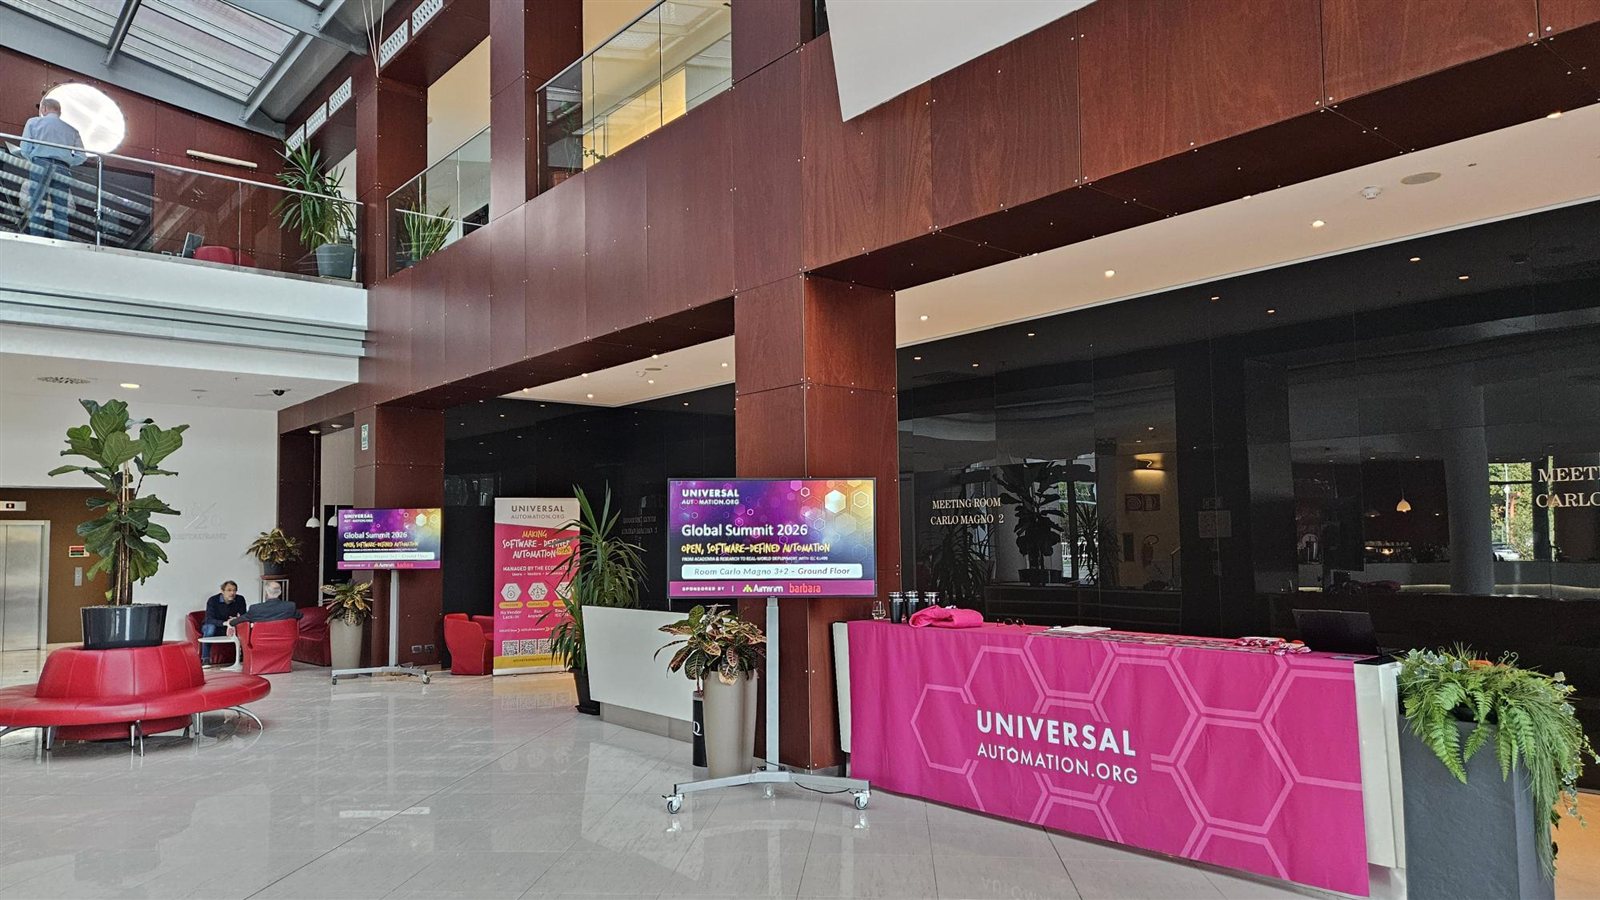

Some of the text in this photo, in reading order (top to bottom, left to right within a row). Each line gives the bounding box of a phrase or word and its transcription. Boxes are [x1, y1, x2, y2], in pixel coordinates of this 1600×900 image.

[1538, 466, 1600, 482] MEET
[682, 489, 739, 497] UNIVERSAL
[932, 497, 1001, 509] MEETING ROOM
[930, 513, 1004, 525] CARLO MAGNO 2
[522, 529, 547, 538] MAKING
[681, 524, 808, 536] Global Summit 2026
[502, 539, 537, 549] SOFTWARE
[681, 542, 830, 555] OPEN, SOFTWARE-DEFINED AUTOMATION
[513, 549, 556, 559] AUTOMATION
[743, 568, 771, 576] Magno
[774, 567, 789, 575] 3+2
[797, 567, 827, 575] Ground
[789, 583, 821, 593] barbara
[977, 709, 1136, 757] UNIVERSAL
[977, 742, 1138, 784] AUTOMATION.ORG
